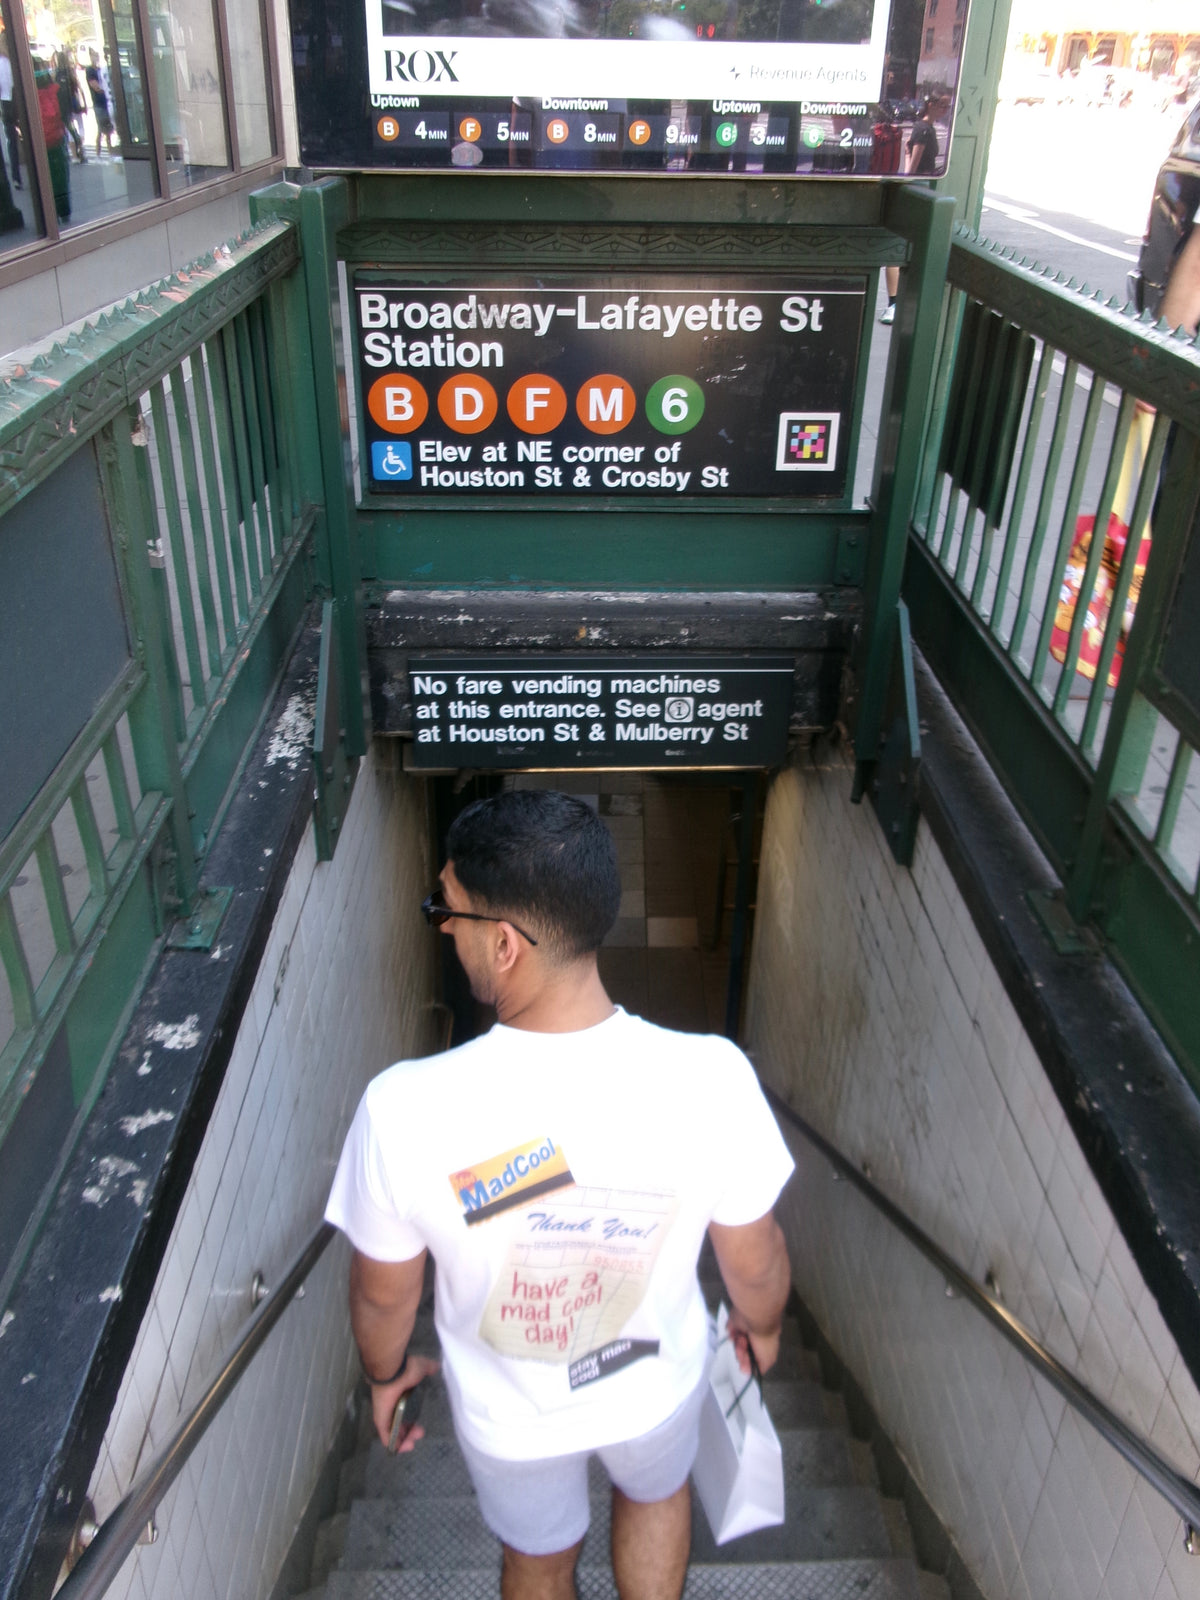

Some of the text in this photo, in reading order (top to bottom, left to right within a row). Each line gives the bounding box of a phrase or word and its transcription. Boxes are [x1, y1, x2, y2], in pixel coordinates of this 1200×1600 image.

[384, 50, 460, 83] ROX
[750, 65, 868, 84] Revenue Agents
[371, 94, 420, 109] Uptown
[541, 97, 608, 111] Downtown
[712, 100, 761, 114] Uptown
[801, 102, 867, 115] Downtown
[360, 293, 824, 338] Broadway-Lafayette St
[364, 332, 504, 368] Station
[384, 387, 689, 423] B D F M 6
[419, 441, 682, 463] Elev at NE corner of
[420, 465, 729, 492] Houston St & Crosby St
[414, 674, 721, 698] No fare vending machines
[416, 701, 439, 720] at
[448, 700, 490, 719] this
[499, 700, 606, 719] entrance.
[615, 699, 661, 718] See
[697, 699, 763, 721] agent
[418, 722, 749, 745] at Houston St & Mulberry St
[458, 1137, 557, 1214] MadCool
[527, 1213, 659, 1240] Thank You!
[511, 1270, 599, 1299] have a
[501, 1285, 602, 1323] mad cool
[525, 1316, 575, 1351] day!
[601, 1340, 632, 1362] mad
[571, 1365, 600, 1387] cool
